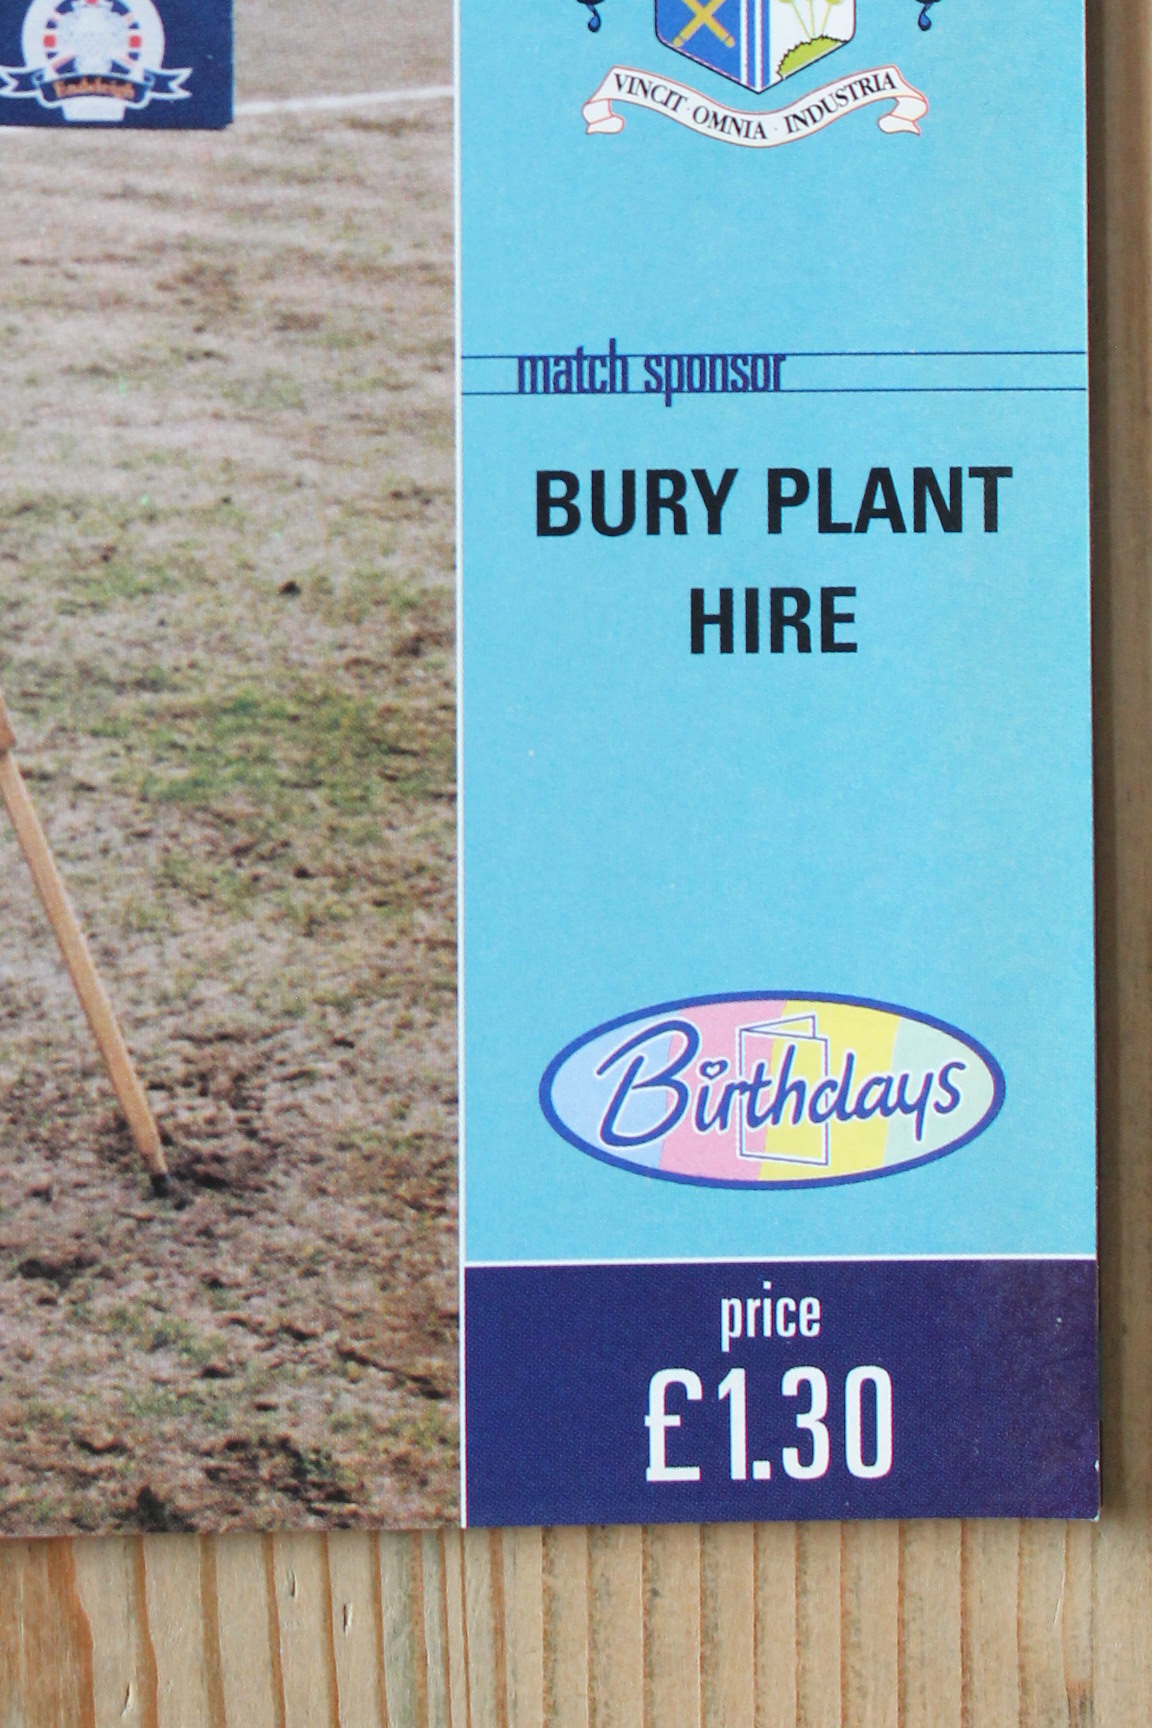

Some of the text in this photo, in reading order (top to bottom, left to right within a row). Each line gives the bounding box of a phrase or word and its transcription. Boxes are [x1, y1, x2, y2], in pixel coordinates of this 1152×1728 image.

[613, 71, 899, 140] VINCIT OMNIA INDUSTRIA
[518, 338, 786, 407] match sponsor
[536, 466, 1013, 537] BURY PLANT
[689, 586, 858, 654] HIRE
[597, 1020, 967, 1147] Birthdays
[720, 1281, 822, 1352] price
[644, 1364, 893, 1482] £1.30
